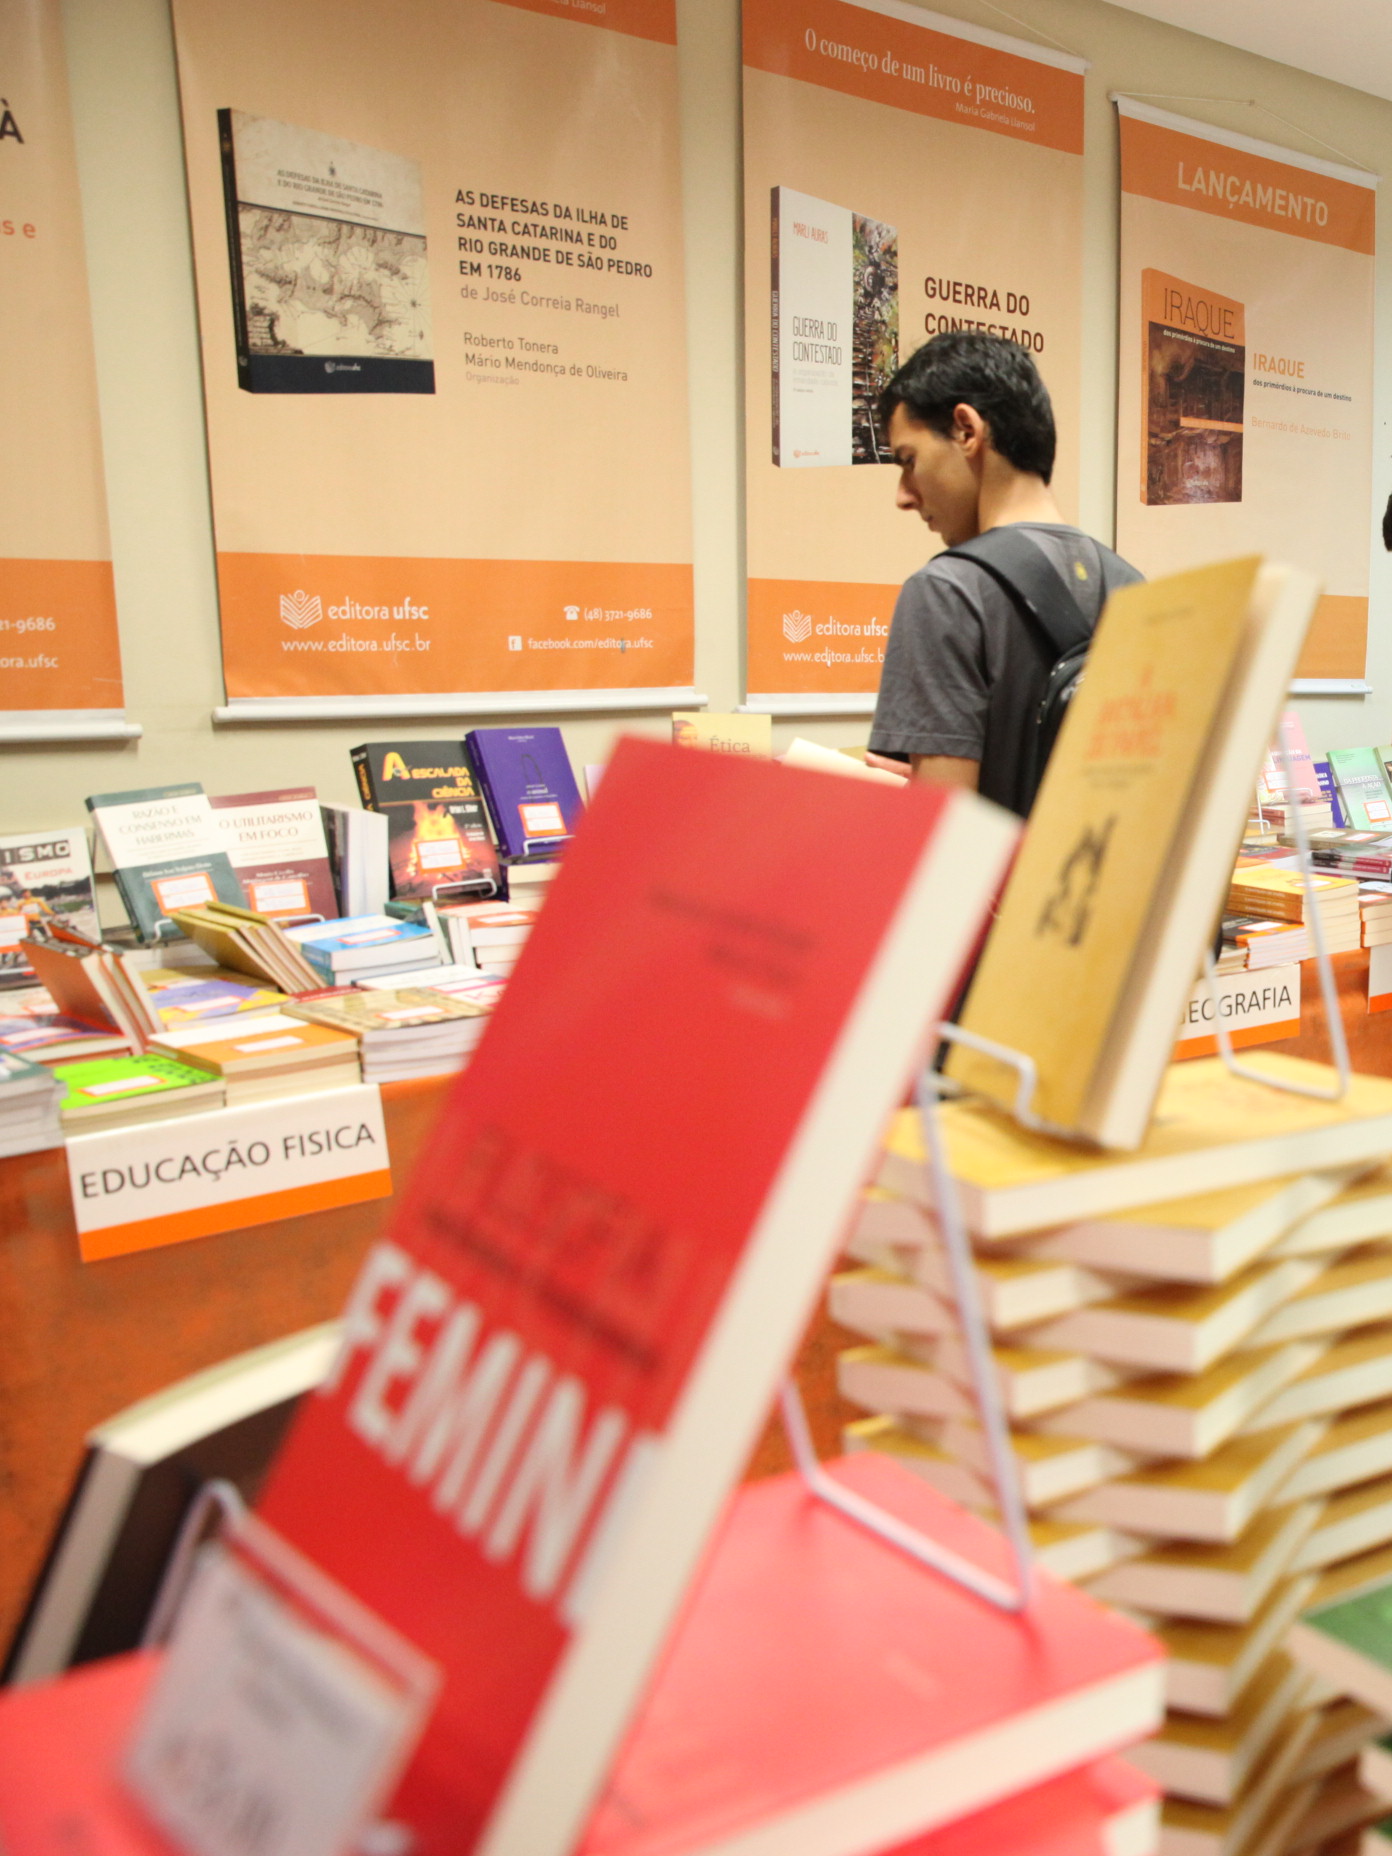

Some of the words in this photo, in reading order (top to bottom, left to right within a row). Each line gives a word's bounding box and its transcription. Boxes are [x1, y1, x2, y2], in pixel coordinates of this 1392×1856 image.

[805, 28, 817, 51] O
[820, 36, 878, 73] começo
[881, 50, 900, 76] de
[902, 63, 925, 83] um
[928, 64, 961, 94] livro
[963, 76, 972, 96] é
[975, 84, 1036, 114] precioso.
[955, 102, 978, 117] Maria
[980, 107, 1009, 126] Gabriela
[1010, 115, 1036, 132] Llansol
[1178, 162, 1328, 226] LANÇAMENTO
[456, 189, 475, 205] AS
[480, 193, 549, 216] DEFESAS
[554, 204, 572, 220] DA
[576, 208, 607, 227] ILHA
[611, 215, 628, 230] DE
[456, 213, 507, 234] SANTA
[512, 222, 583, 245] CATARINA
[587, 233, 595, 247] E
[599, 235, 617, 250] DO
[458, 237, 483, 253] RIO
[488, 241, 550, 263] GRANDE
[556, 250, 573, 266] DE
[577, 252, 603, 271] SÃO
[607, 259, 653, 278] PEDRO
[460, 261, 481, 277] EM
[487, 264, 522, 281] 1786
[461, 284, 478, 299] de
[483, 287, 516, 304] José
[520, 291, 571, 311] Correia
[575, 298, 620, 319] Rangel
[925, 276, 1001, 312] GUERRA
[1007, 292, 1030, 316] DO
[1163, 288, 1234, 339] IRAQUE
[793, 316, 824, 339] GUERRA
[827, 322, 838, 341] DO
[464, 332, 514, 350] Roberto
[517, 337, 559, 354] Tonera
[793, 341, 842, 366] CONTESTADO
[465, 353, 501, 369] Mário
[505, 357, 566, 377] Mendonça
[569, 364, 583, 376] de
[586, 365, 628, 381] Oliveira
[1253, 353, 1305, 379] IRAQUE
[1253, 379, 1263, 387] dos
[1296, 387, 1316, 397] procura
[1333, 393, 1352, 402] destino
[1251, 416, 1287, 432] Bernardo
[1290, 423, 1299, 433] de
[328, 597, 389, 621] editora
[394, 598, 429, 620] ufsc
[584, 607, 603, 621] (48)
[605, 608, 653, 622] 3721-9686
[815, 616, 861, 636] editora
[863, 617, 889, 637] ufsc
[281, 633, 431, 653] www.editora.ufsc.br
[528, 637, 654, 652] facebook.com/editora.ufsc
[783, 647, 886, 664] www.editora.ufsc.b
[709, 734, 751, 753] Ética
[382, 751, 411, 781] A
[411, 766, 470, 779] ESCALADA
[432, 785, 475, 798] CIÊNCIA
[455, 776, 473, 787] DA
[219, 819, 230, 830] O
[233, 811, 313, 829] UTILITARISMO
[239, 831, 258, 843] EM
[260, 827, 299, 840] FOCO
[1181, 985, 1292, 1025] EOGRAFIA
[80, 1140, 270, 1199] EDUCAÇÃO
[283, 1122, 376, 1160] FISICA
